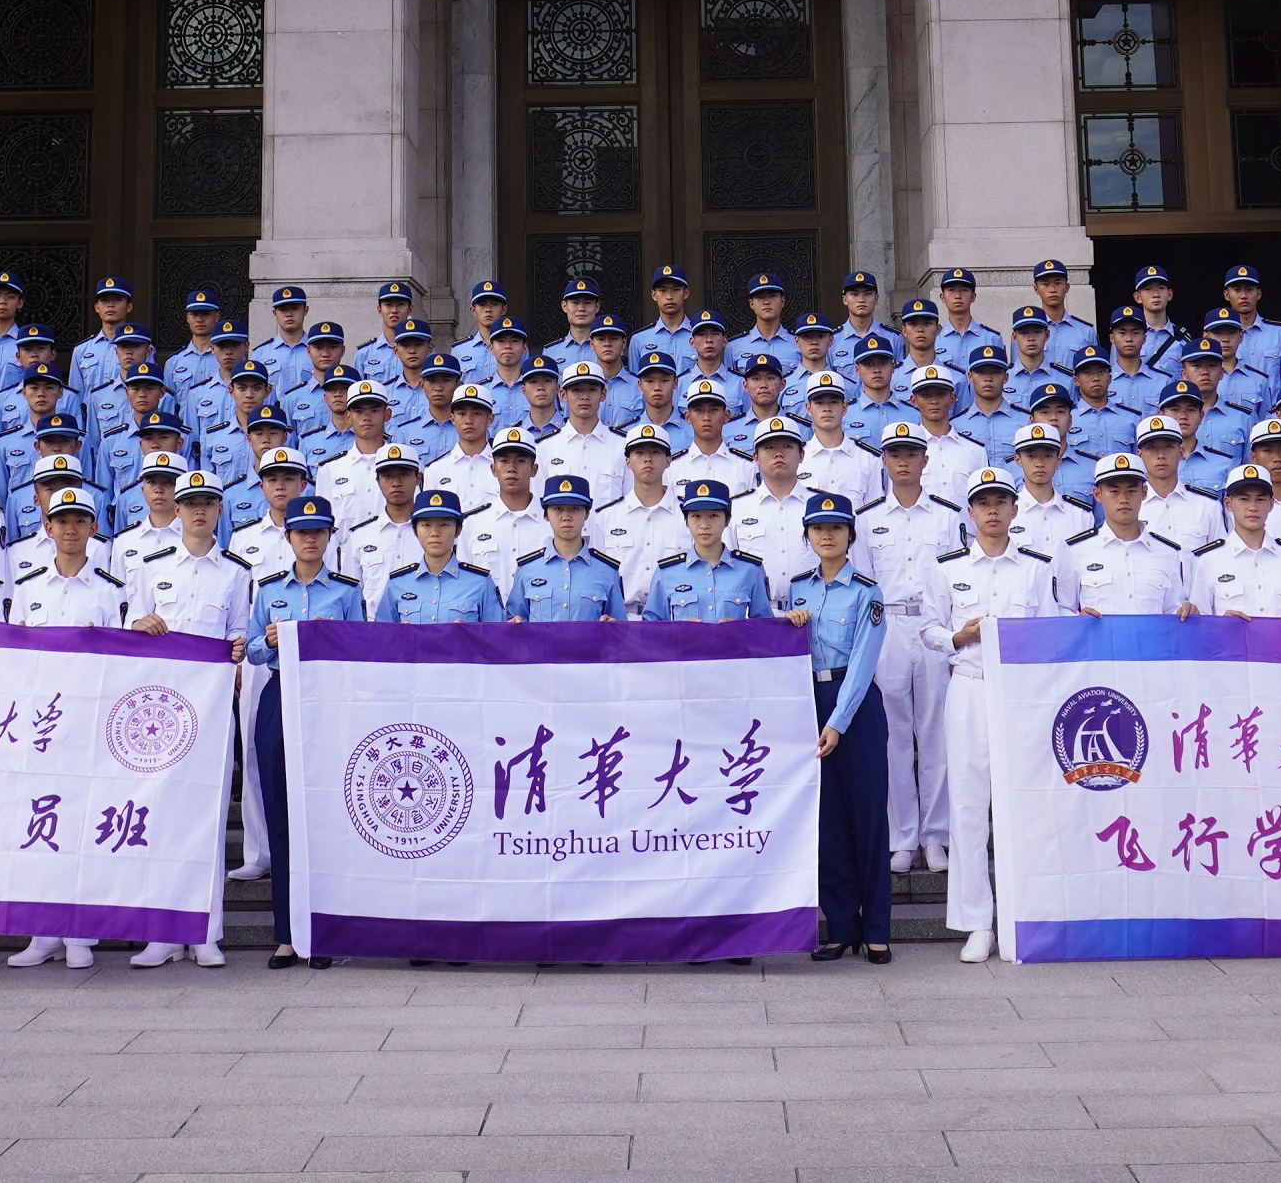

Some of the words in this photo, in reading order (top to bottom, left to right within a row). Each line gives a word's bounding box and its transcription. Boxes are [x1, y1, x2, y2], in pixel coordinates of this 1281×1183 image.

[1061, 699, 1077, 718] NAVAL
[1078, 689, 1105, 701] AVIATION
[1108, 691, 1137, 717] UNIVERSITY
[356, 774, 379, 832] TSINGHUA
[433, 776, 460, 835] UNIVERSITY
[493, 829, 620, 862] Tsinghua
[631, 824, 773, 855] University
